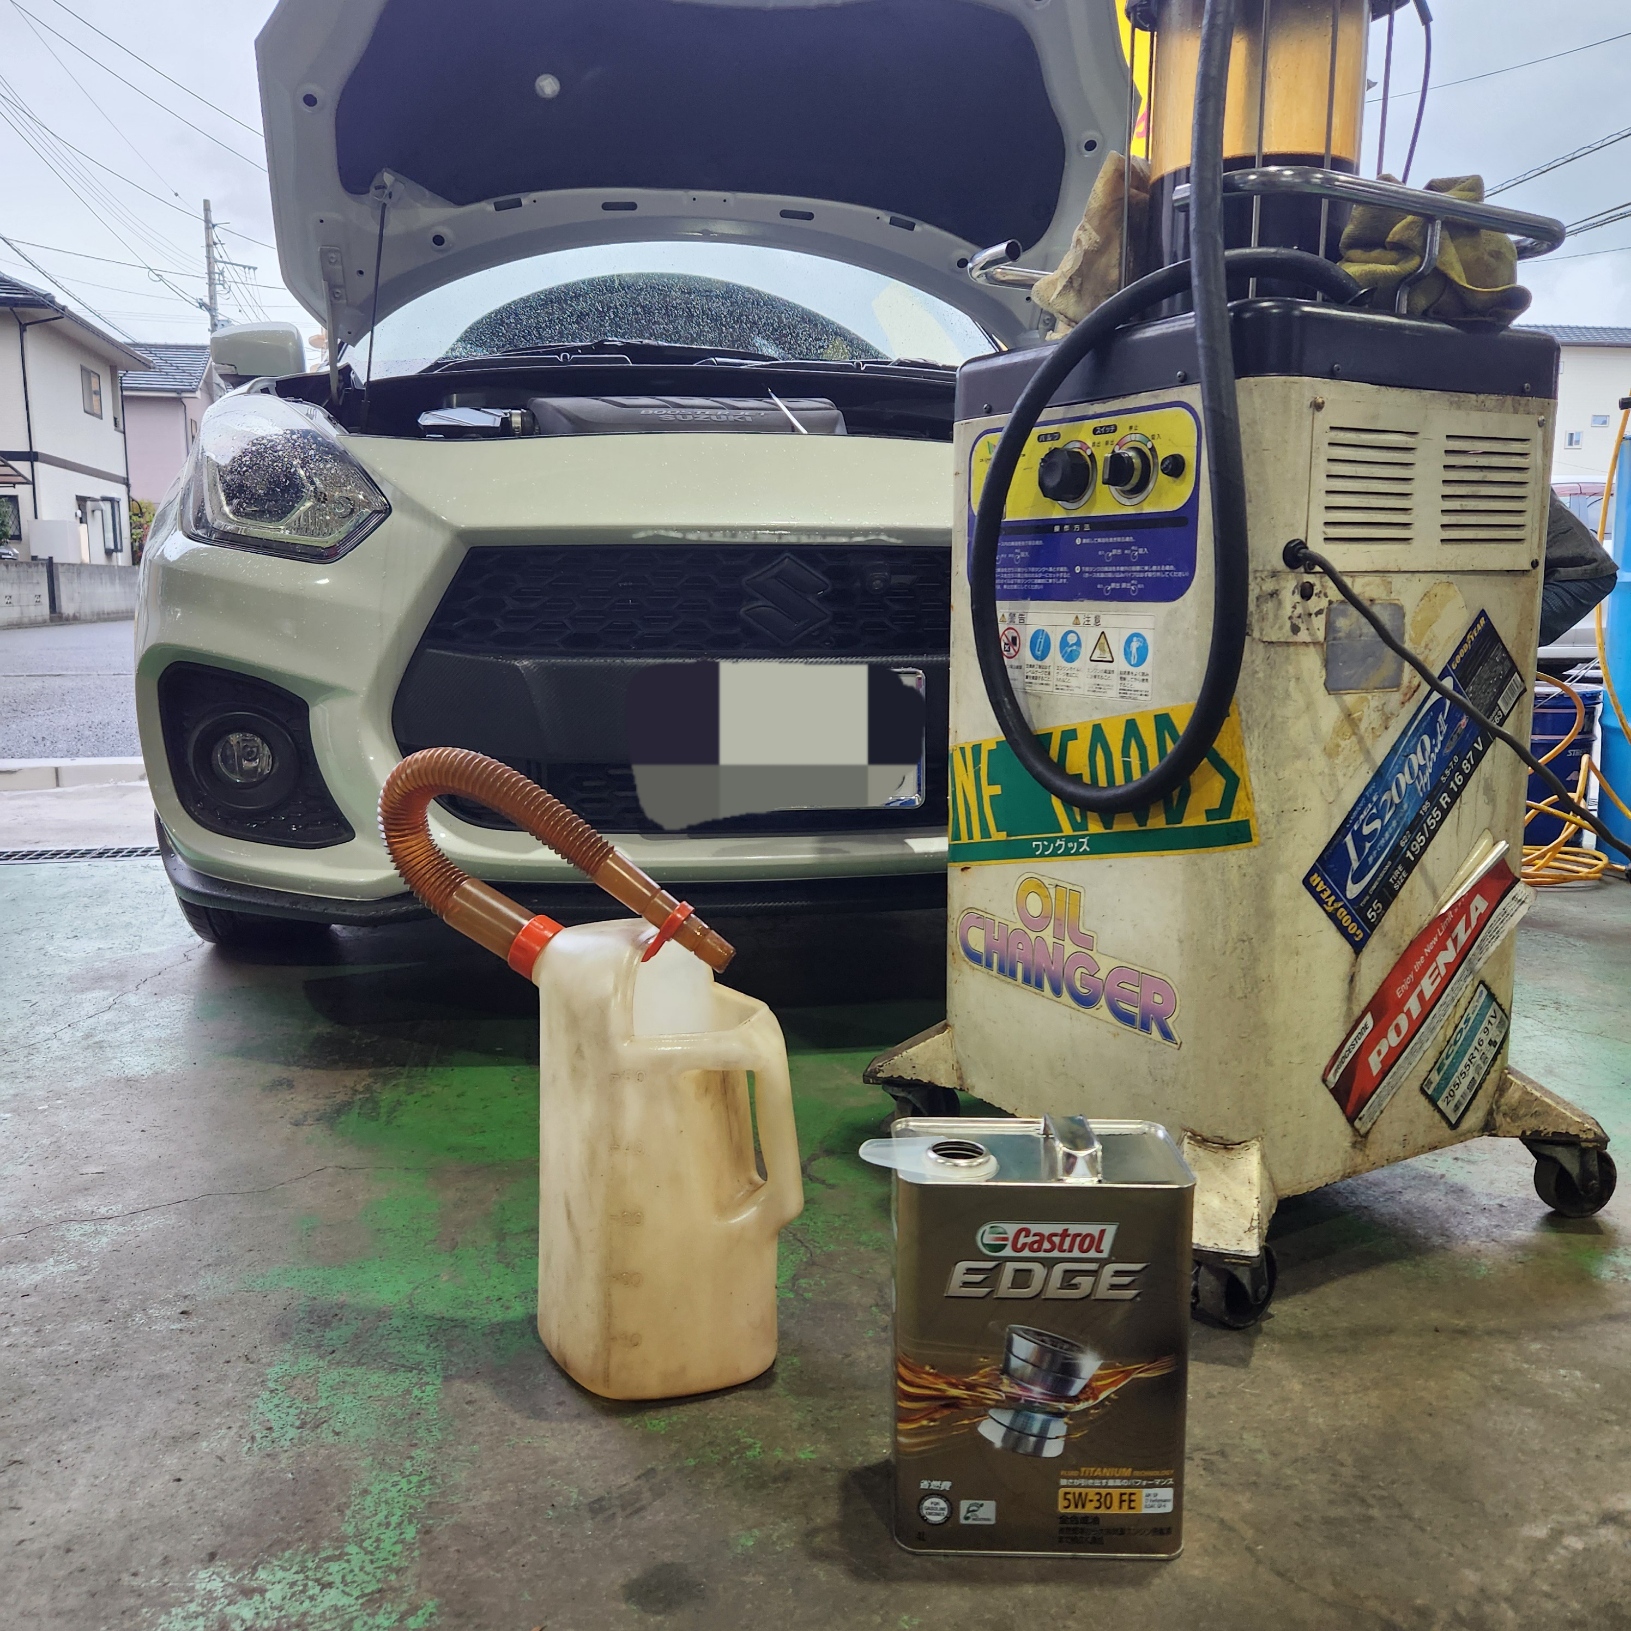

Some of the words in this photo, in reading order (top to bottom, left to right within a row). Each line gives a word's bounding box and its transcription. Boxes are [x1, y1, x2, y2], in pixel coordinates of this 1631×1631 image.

[660, 414, 753, 422] SUZUKI
[1095, 425, 1117, 434] スイッチ
[1008, 612, 1026, 624] 警告
[1083, 614, 1101, 627] 注意
[1451, 616, 1487, 670] GOODYEAR
[949, 742, 1007, 841] NE
[1343, 735, 1432, 874] LS2000
[1353, 792, 1379, 830] EAGLE
[1399, 831, 1411, 847] 622
[1419, 799, 1431, 816] 195
[1440, 755, 1459, 783] 5.5-7.0
[1405, 806, 1442, 861] 195/55
[1439, 792, 1452, 809] R
[1449, 773, 1463, 793] 16
[1461, 751, 1476, 774] 87
[1473, 736, 1485, 752] V
[1032, 836, 1090, 855] ワングッズ
[1388, 864, 1404, 885] TIRE
[1393, 871, 1409, 891] SIZE
[1016, 876, 1095, 951] OIL
[1309, 872, 1365, 942] GOODYEAR
[1366, 899, 1383, 923] 55
[1396, 970, 1415, 999] Enjoy
[1414, 954, 1426, 973] the
[1423, 937, 1439, 957] New
[1436, 912, 1454, 939] Limit
[958, 911, 1179, 1045] CHANGER
[1367, 893, 1489, 1077] POTENZA
[1437, 1013, 1471, 1076] ECOS
[1443, 1037, 1485, 1107] 205/55R16
[1482, 1008, 1498, 1037] 91V
[1011, 1227, 1106, 1253] Castrol
[944, 1261, 1150, 1300] EDGE
[1080, 1467, 1133, 1477] TITANIUM
[1063, 1492, 1113, 1510] 5W-30
[1119, 1492, 1137, 1510] FE
